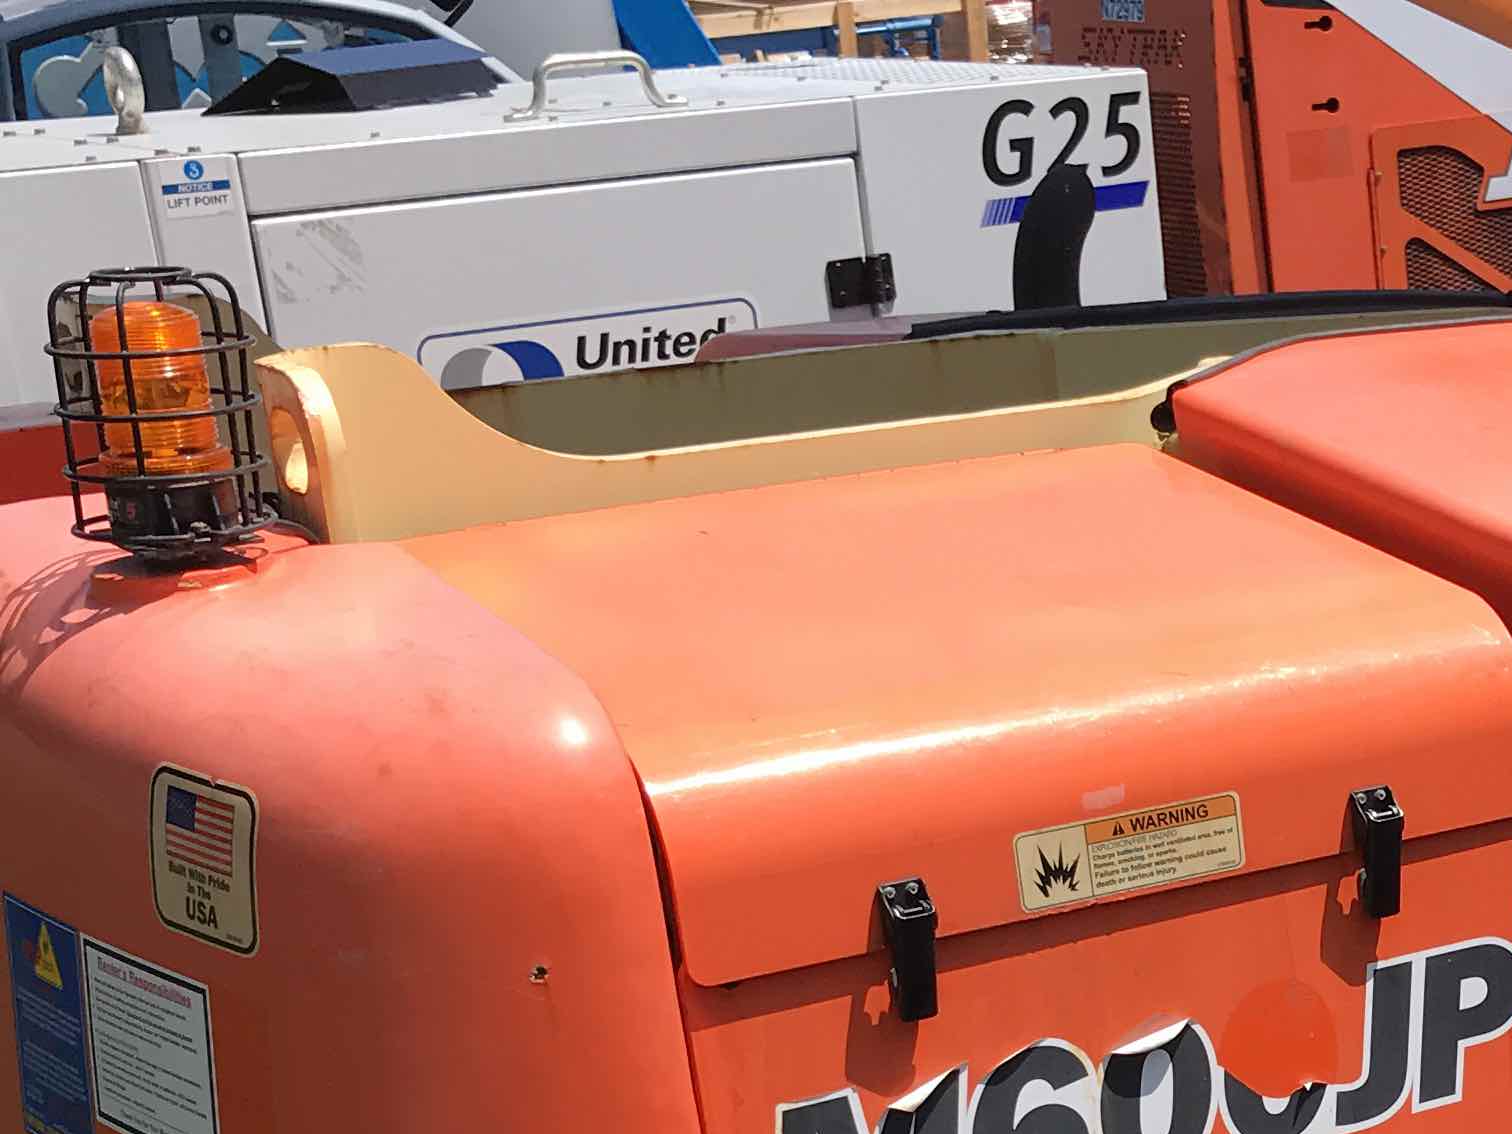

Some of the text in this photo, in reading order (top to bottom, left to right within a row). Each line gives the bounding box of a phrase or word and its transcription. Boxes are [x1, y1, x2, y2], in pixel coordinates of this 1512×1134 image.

[982, 91, 1141, 187] G25
[168, 195, 228, 209] LIFT POINT
[178, 182, 213, 194] NOTICE
[1130, 804, 1209, 832] WARNING
[186, 896, 218, 929] USA
